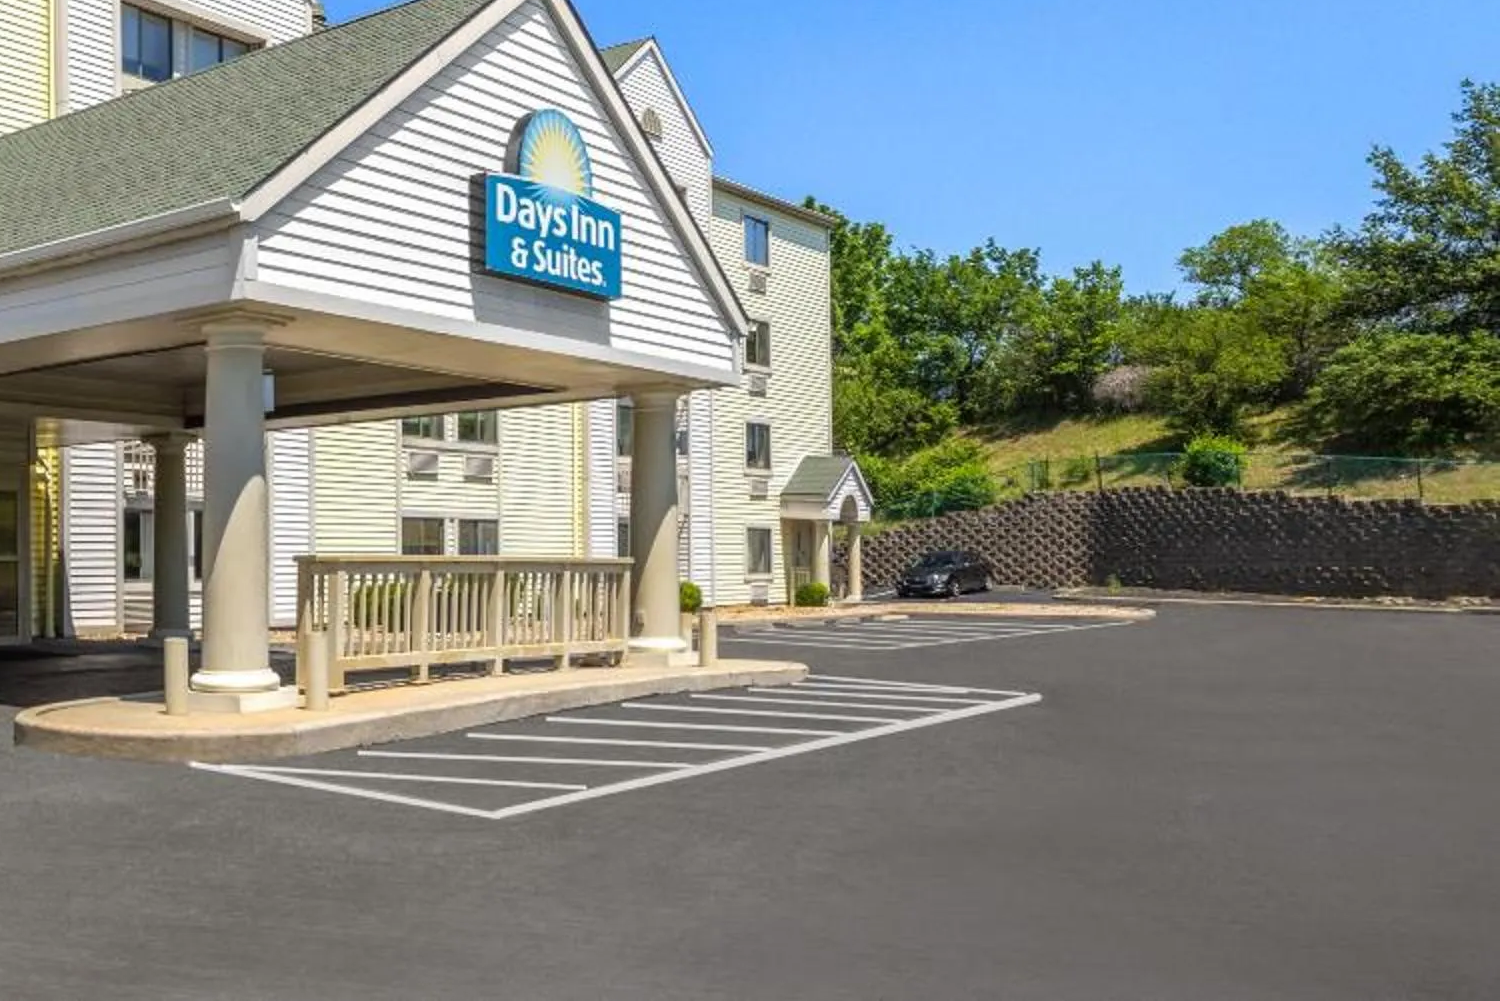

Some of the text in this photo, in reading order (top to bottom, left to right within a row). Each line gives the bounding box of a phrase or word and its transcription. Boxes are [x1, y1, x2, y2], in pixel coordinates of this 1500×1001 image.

[496, 183, 615, 251] Days Inn
[511, 237, 603, 286] & Suites
